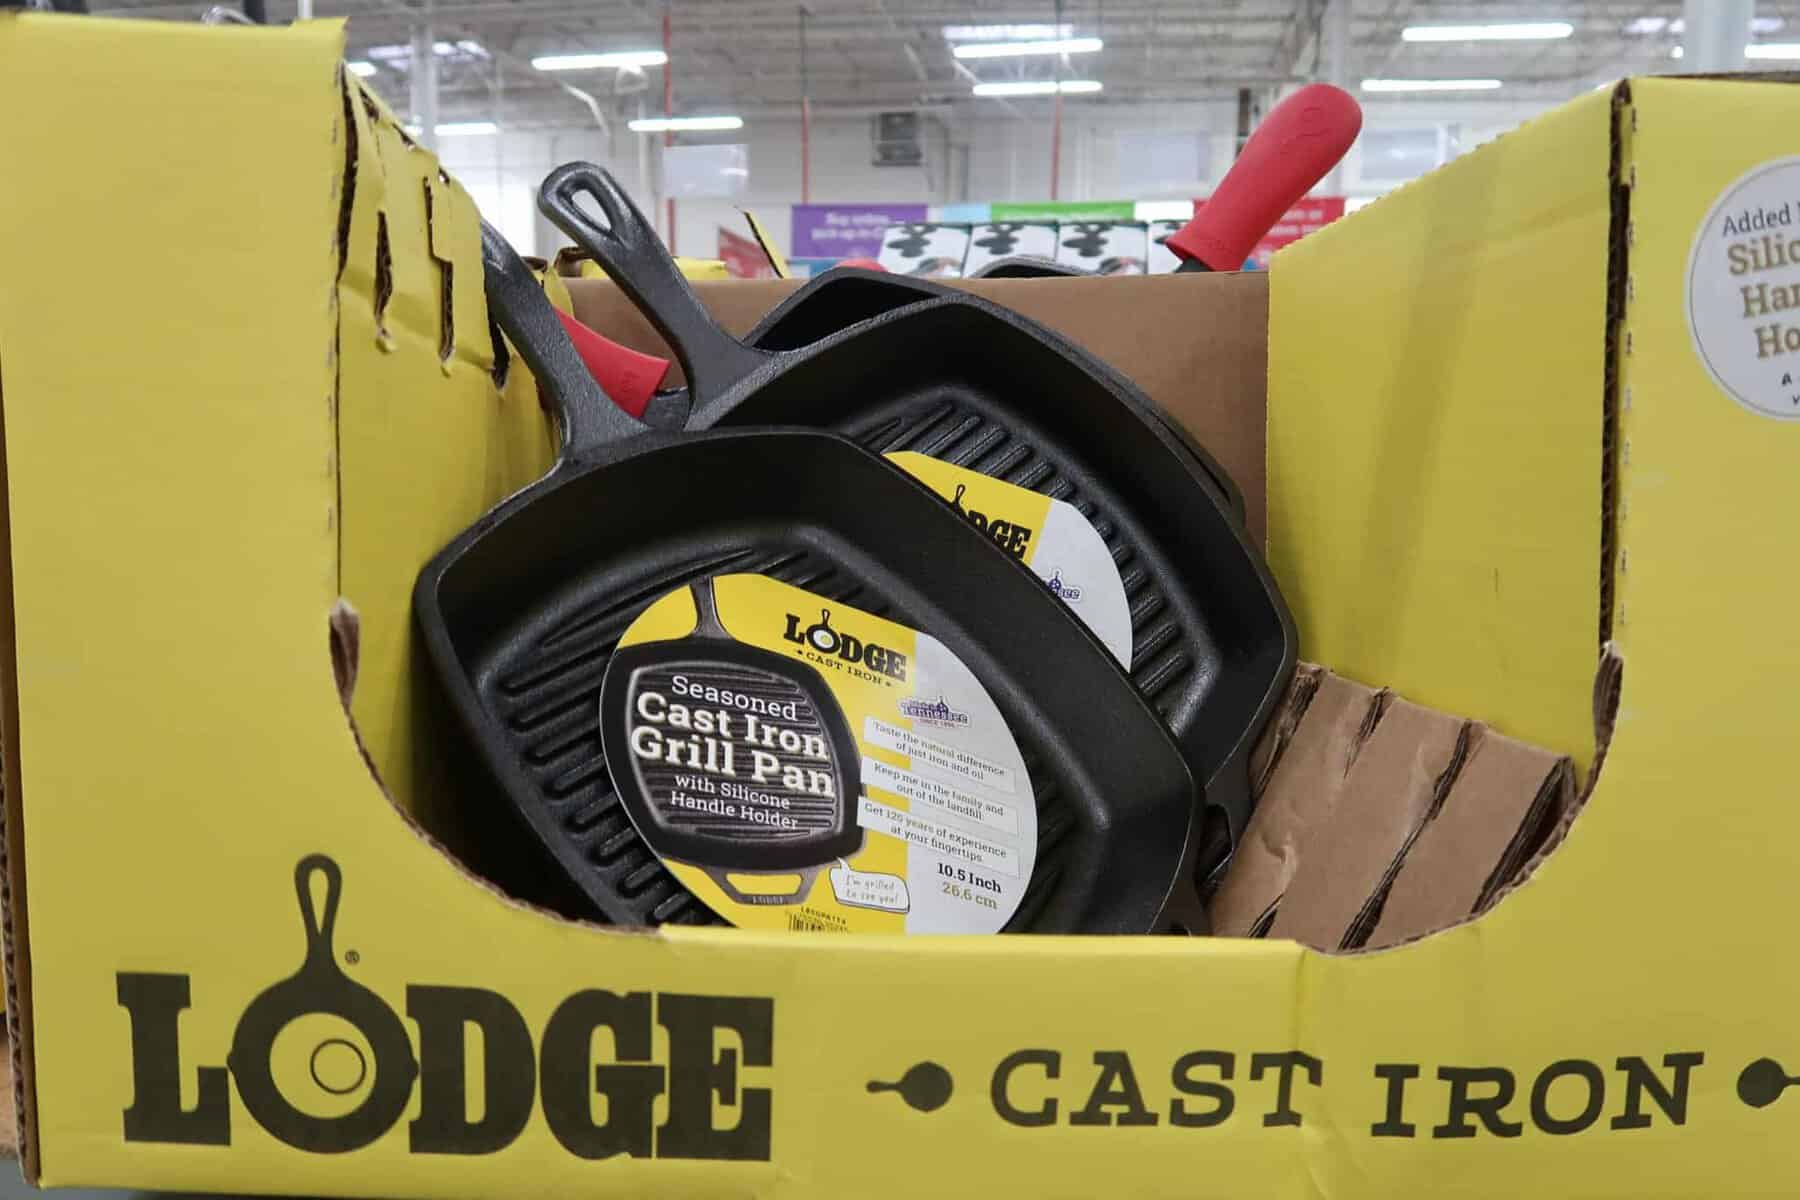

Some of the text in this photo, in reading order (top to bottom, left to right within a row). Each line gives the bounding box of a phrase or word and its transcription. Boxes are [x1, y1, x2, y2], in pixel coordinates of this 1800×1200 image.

[1723, 204, 1791, 237] Added
[784, 608, 907, 682] LODGE
[807, 653, 882, 686] CAST IRON
[671, 674, 799, 722] Seasoned
[637, 691, 831, 761] Cast Iron
[631, 725, 837, 799] Grill Pan
[873, 721, 1005, 776] Taste the natural difference
[896, 741, 984, 780] of just iron and oil
[671, 790, 799, 830] Handle Holder
[675, 775, 791, 810] with Silicone
[874, 762, 1004, 816] Keep me in the family and
[896, 784, 914, 797] out
[916, 790, 927, 801] of
[929, 793, 945, 806] the
[864, 803, 884, 817] Get
[905, 816, 935, 833] years
[936, 827, 947, 839] of
[949, 832, 1007, 859] experience
[890, 826, 983, 863] at your fingertips
[937, 862, 1002, 894] 10.5 Inch
[975, 894, 998, 910] cm
[115, 853, 775, 1162] LODGE
[990, 1048, 1705, 1139] CAST IRON
